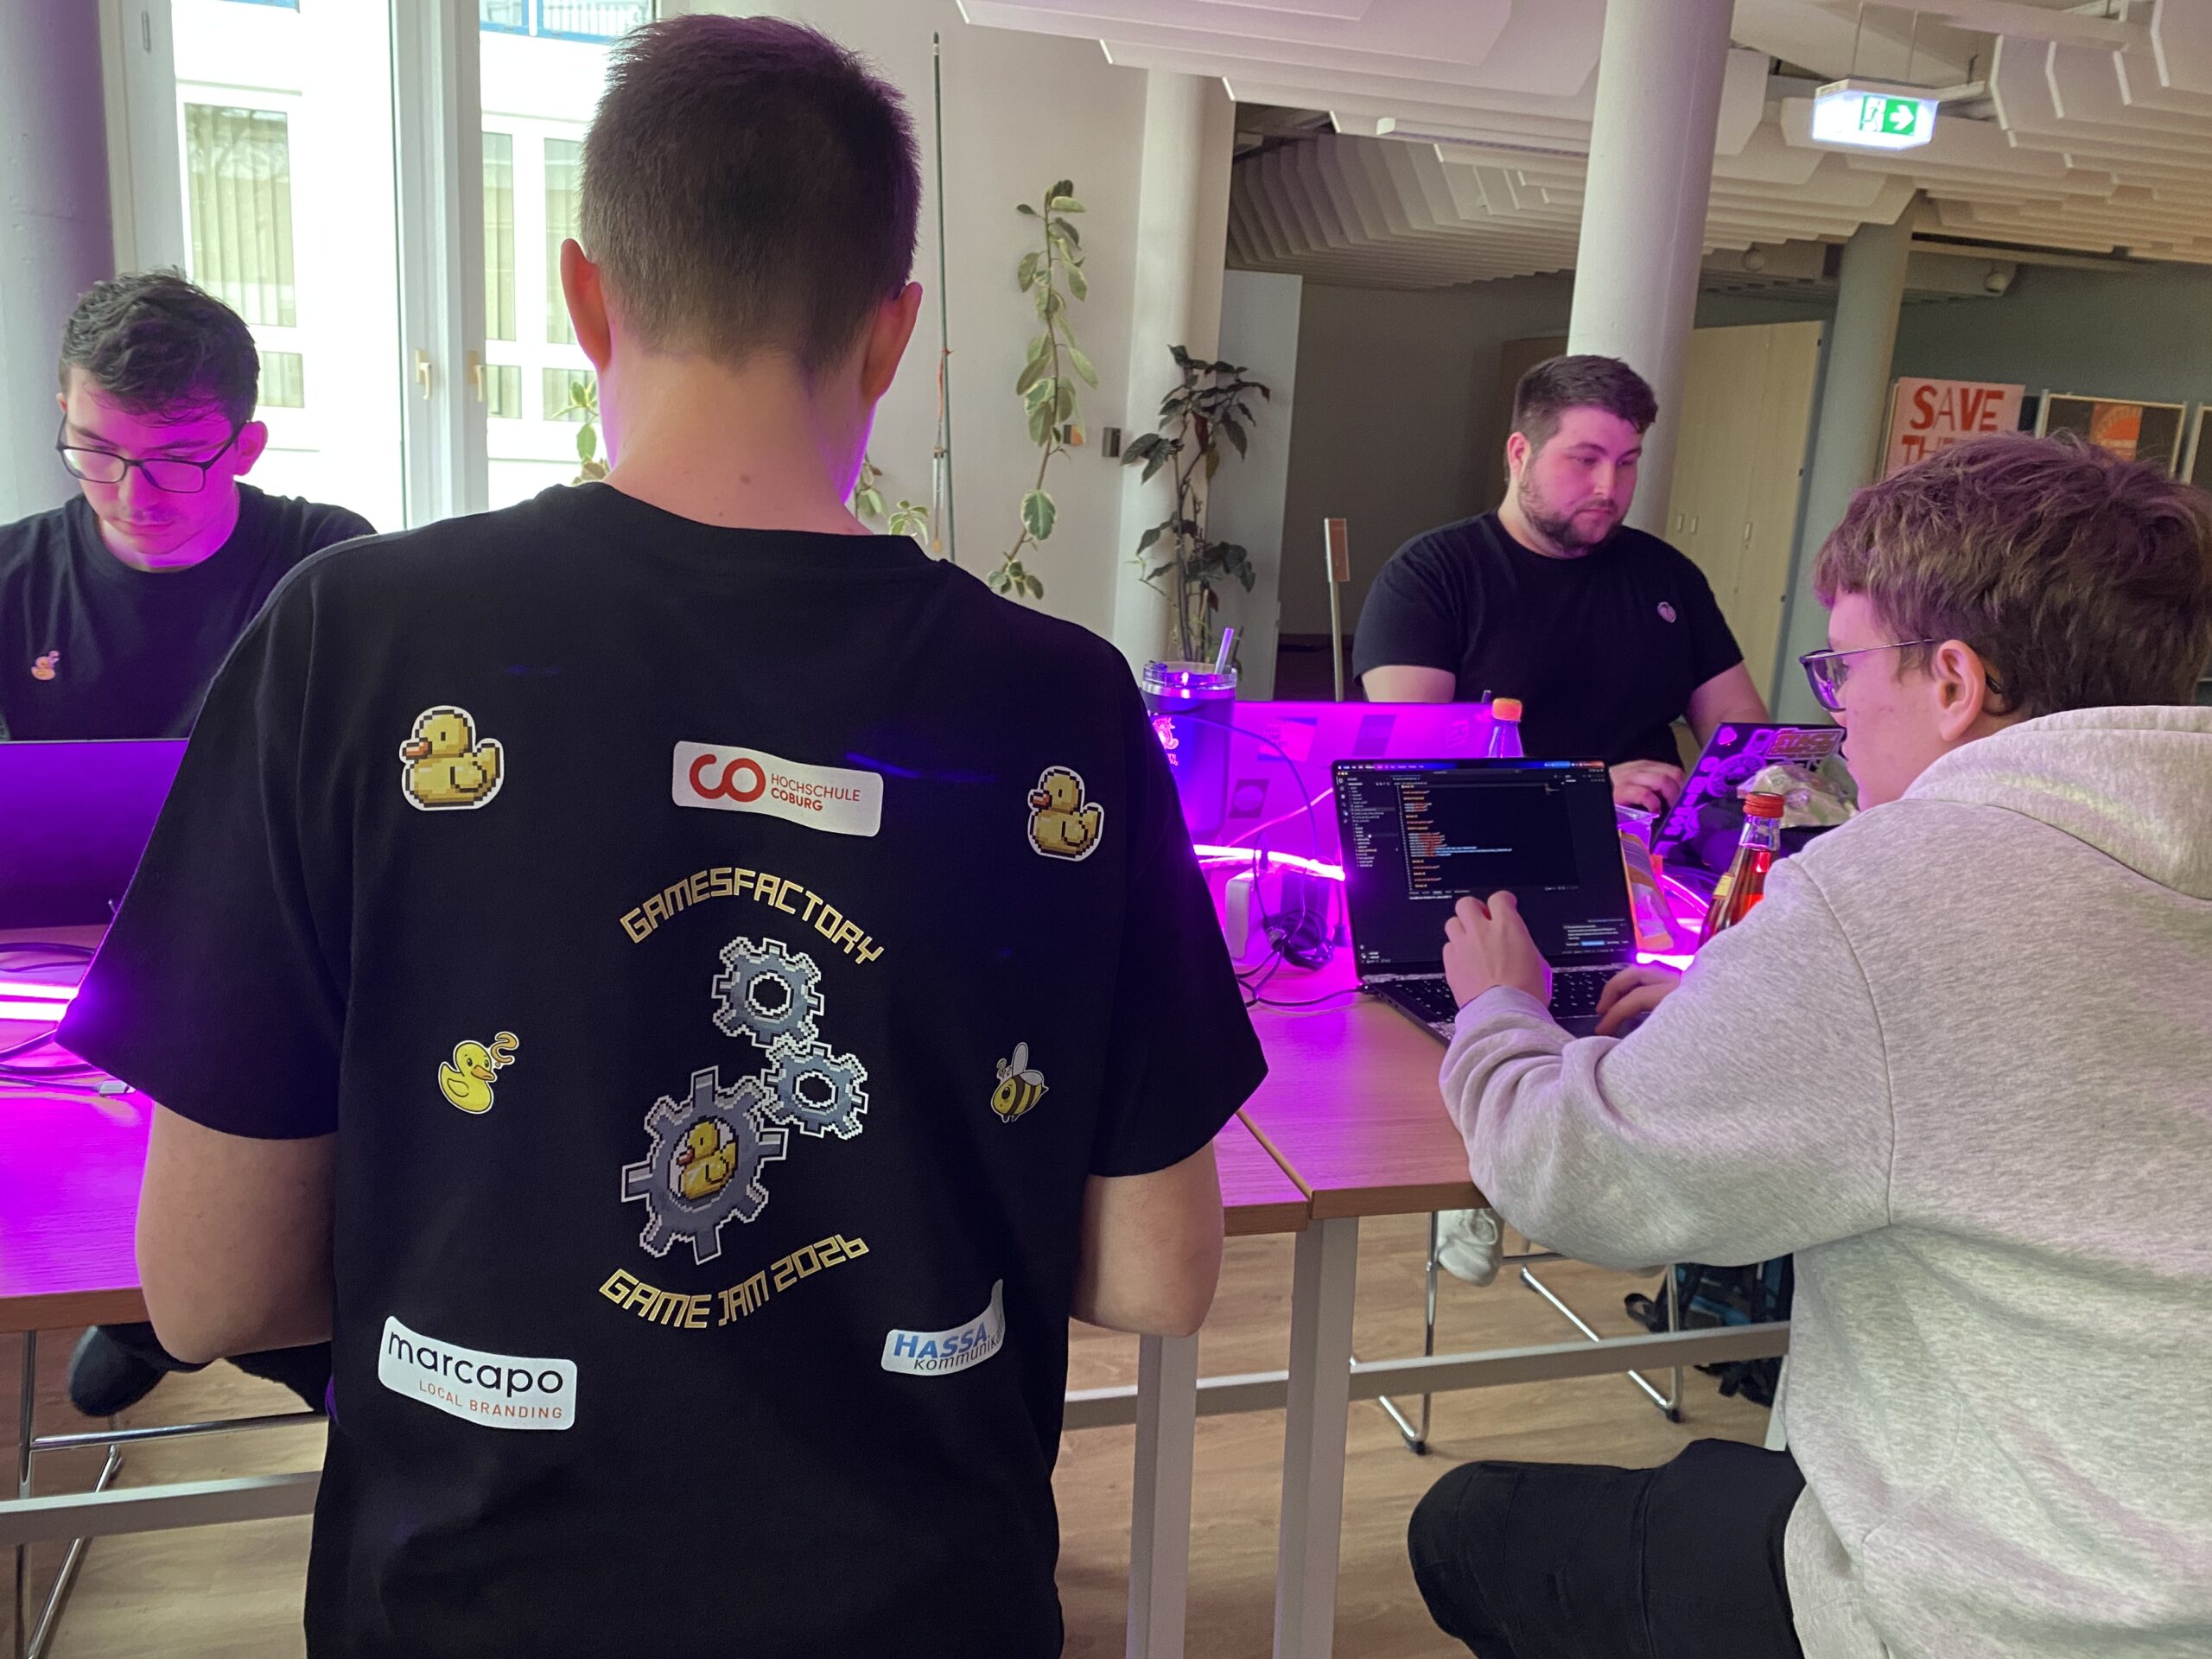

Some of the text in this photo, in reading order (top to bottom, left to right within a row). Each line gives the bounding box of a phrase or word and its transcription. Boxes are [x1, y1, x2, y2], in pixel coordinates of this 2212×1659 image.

[1910, 385, 2005, 431] SAVE
[1902, 435, 1956, 465] TH
[771, 772, 861, 802] HOCHSCHULE
[771, 787, 823, 811] COBURG
[620, 868, 885, 964] GAMESFACTORY
[599, 1234, 869, 1328] GAME JAM 2026
[389, 1332, 563, 1398] marcapo
[419, 1380, 563, 1420] LOCAL BRANDING
